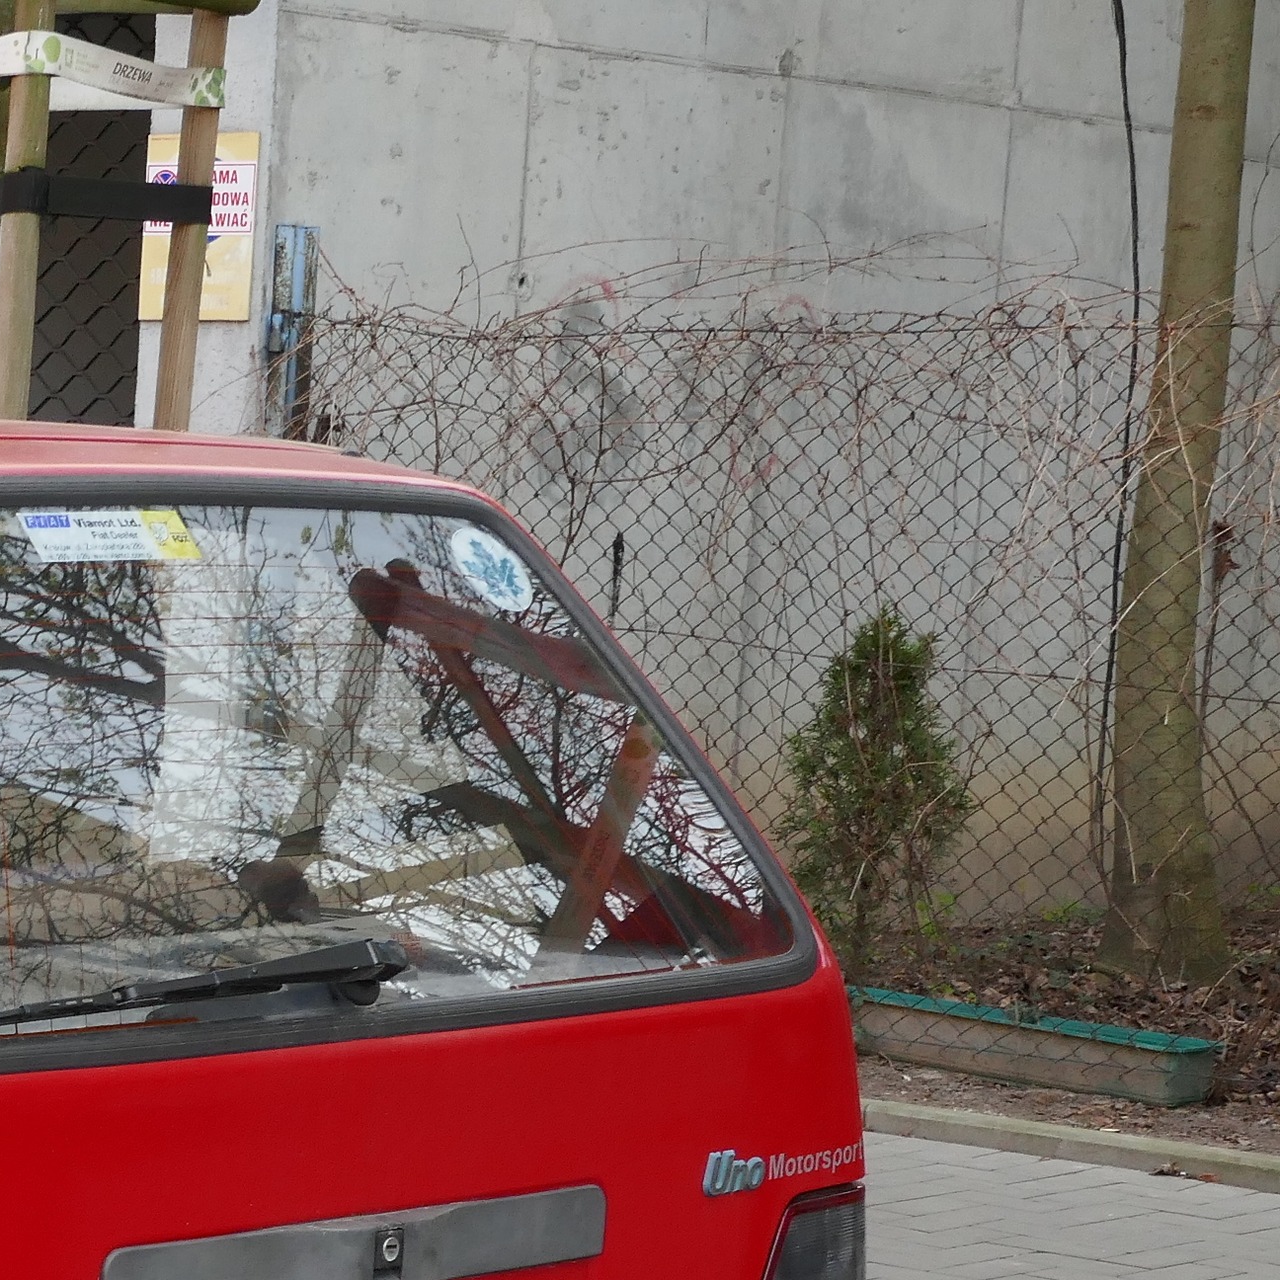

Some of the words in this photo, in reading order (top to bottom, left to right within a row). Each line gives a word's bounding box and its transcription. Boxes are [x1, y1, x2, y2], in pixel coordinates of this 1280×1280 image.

[112, 62, 153, 84] DRZEWA
[212, 170, 238, 184] AMA
[212, 192, 249, 206] DOWA
[209, 209, 248, 227] AWIAĆ
[25, 515, 70, 528] FIAT
[73, 518, 115, 528] Viamot
[703, 1149, 765, 1197] Uno
[768, 1139, 863, 1181] Motorsport
